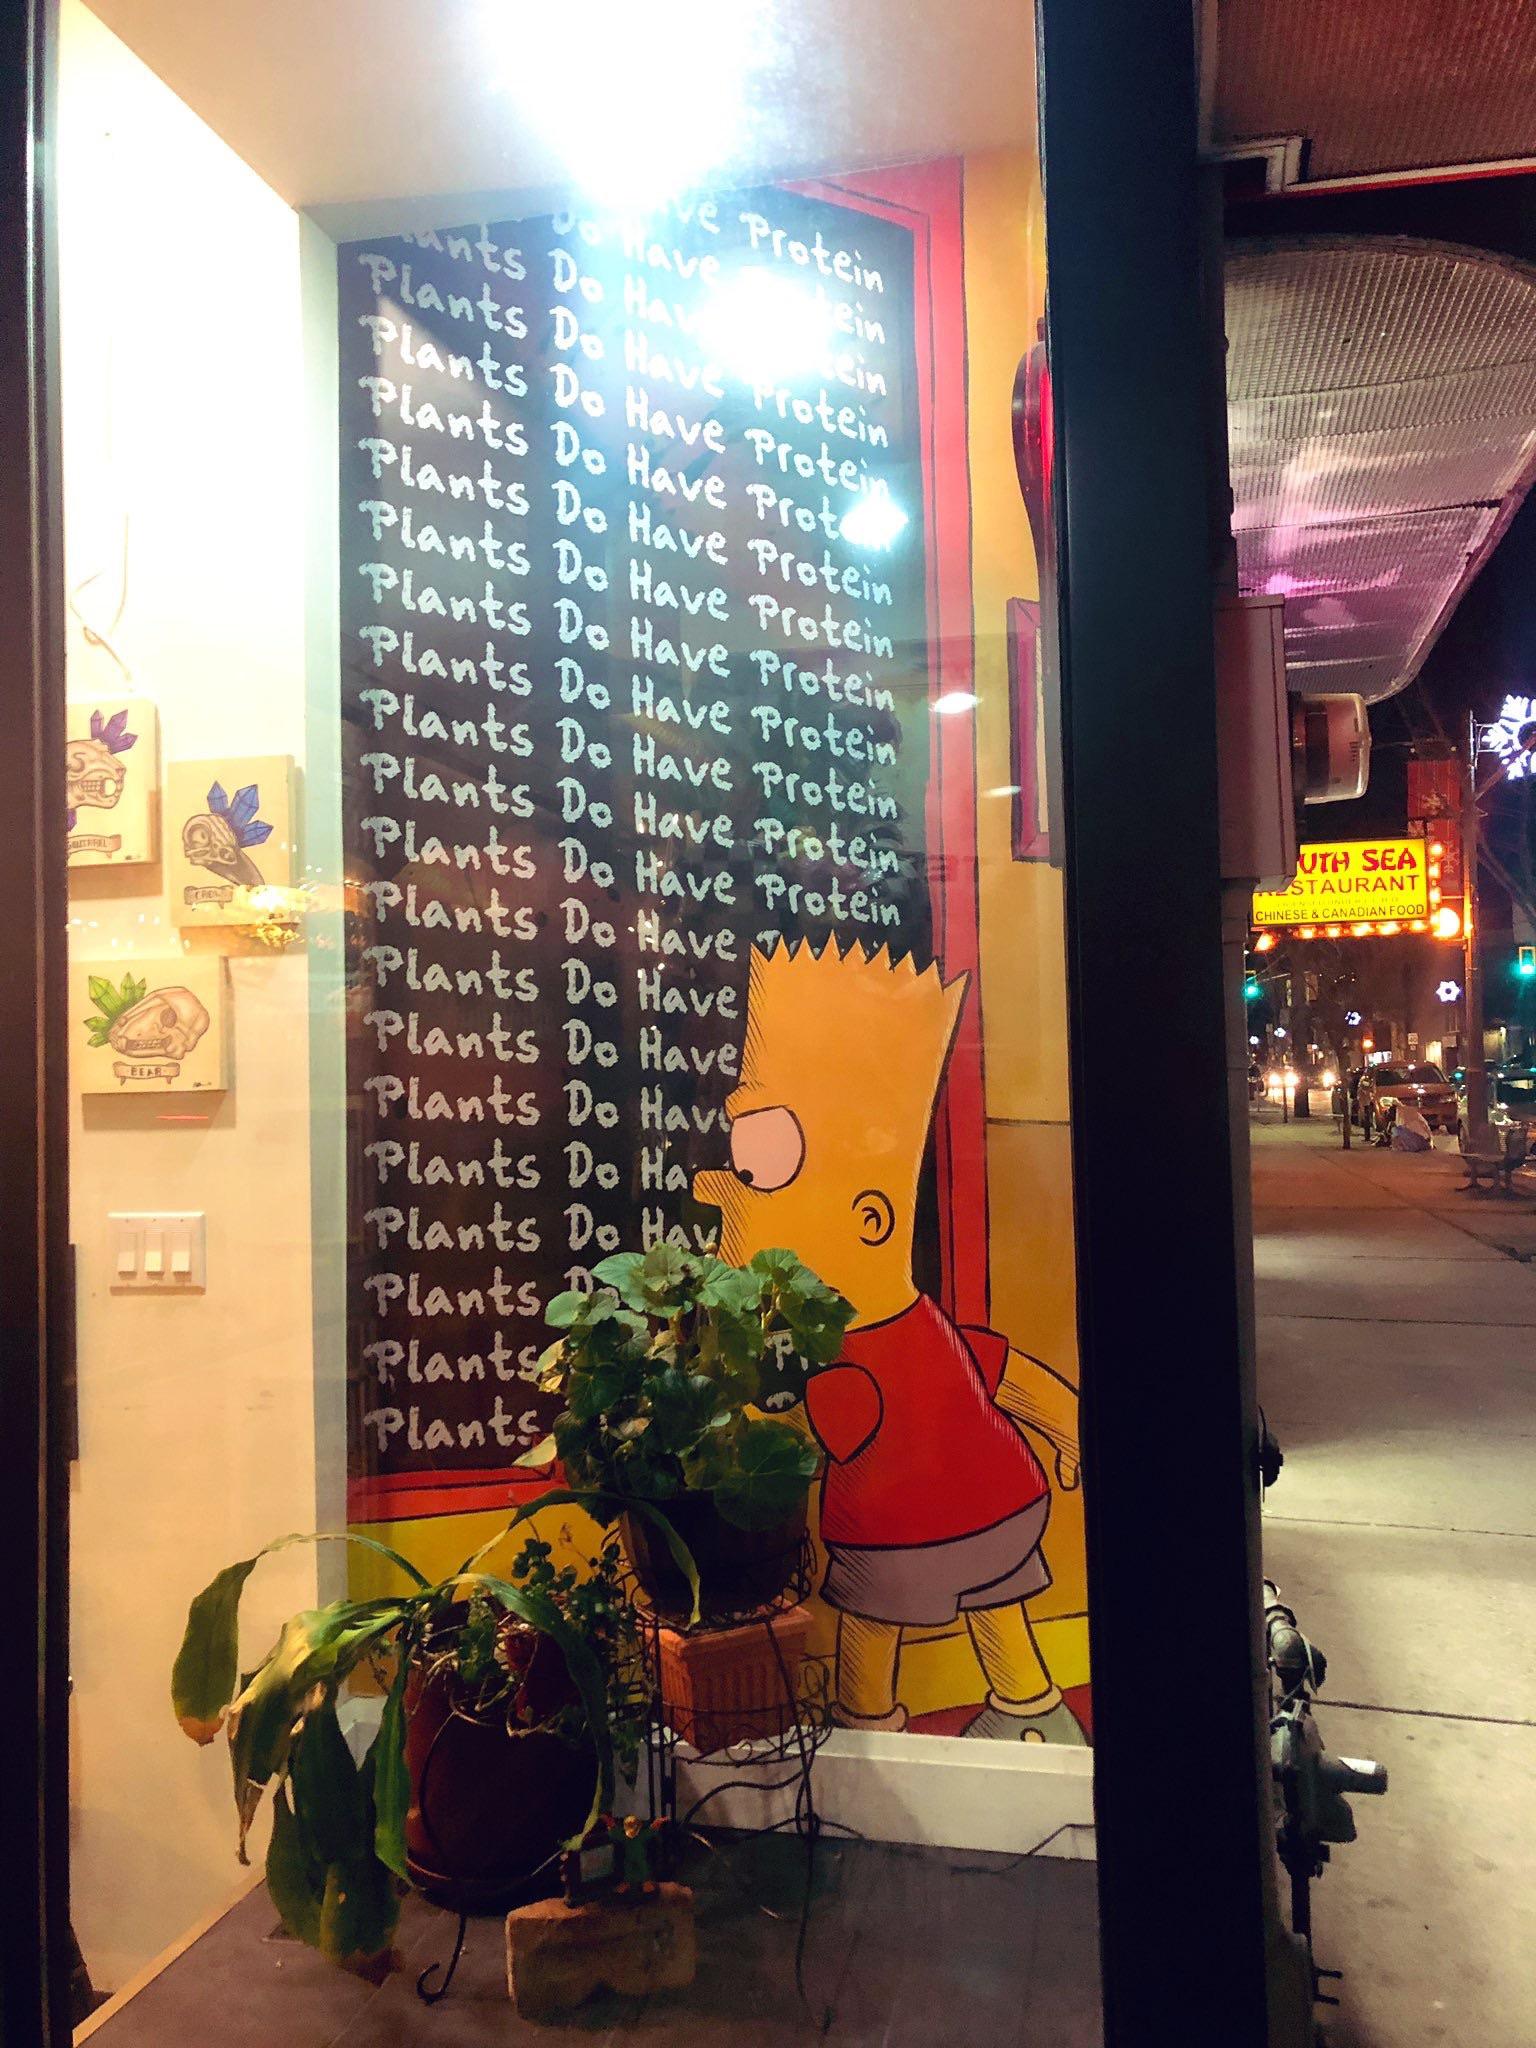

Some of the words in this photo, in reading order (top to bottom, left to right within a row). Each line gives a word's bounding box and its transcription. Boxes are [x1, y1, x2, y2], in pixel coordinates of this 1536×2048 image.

[401, 223, 527, 281] ants
[548, 248, 604, 304] Do
[624, 273, 702, 336] Hav
[738, 211, 884, 293] Protein
[360, 254, 528, 339] Plants
[549, 306, 604, 361] Do
[359, 315, 528, 397] Plants
[549, 363, 604, 416] Do
[626, 385, 726, 454] Have
[358, 376, 529, 456] Plants
[550, 421, 606, 475] Do
[627, 443, 727, 509] Have
[746, 484, 870, 548] Prot
[358, 438, 530, 516] Plants
[551, 480, 608, 533] Do
[629, 501, 728, 565] Have
[747, 539, 892, 606] Protein
[359, 500, 531, 576] Plants
[552, 539, 609, 591] Do
[630, 559, 729, 621] Have
[748, 594, 894, 660] Protein
[359, 563, 532, 636] Plants
[553, 598, 610, 651] Do
[631, 616, 730, 678] Have
[750, 650, 895, 713] Protein
[359, 625, 533, 696] Plants
[554, 657, 611, 709] Do
[632, 674, 732, 735] Have
[751, 705, 896, 767] Protein
[359, 689, 534, 757] Plants
[555, 717, 612, 769] Do
[633, 733, 733, 791] Have
[752, 761, 898, 822] Protein
[360, 752, 535, 818] Plants
[556, 777, 613, 828] Do
[634, 791, 734, 848] Have
[753, 818, 899, 874] Protein
[360, 816, 536, 879] Plants
[558, 837, 615, 888] Do
[636, 850, 736, 905] Have
[755, 873, 901, 927] Protein
[1258, 875, 1420, 896] STAURANT
[1299, 851, 1350, 874] UTH
[1362, 848, 1417, 872] SEA
[362, 881, 538, 940] Plants
[559, 898, 616, 948] Do
[637, 909, 737, 962] Have
[1255, 909, 1308, 922] CHINESE
[1311, 909, 1319, 919] &
[1322, 906, 1386, 919] CANADIAN
[1389, 904, 1425, 916] FOOD
[363, 944, 539, 1002] Plants
[561, 958, 618, 1008] Do
[638, 966, 738, 1019] Have
[363, 1010, 540, 1063] Plants
[562, 1018, 619, 1068] Do
[640, 1025, 738, 1076] Have
[363, 1075, 541, 1126] Plants
[562, 1079, 619, 1128] Do
[363, 1138, 541, 1189] Plants
[563, 1141, 620, 1190] Do
[640, 1146, 712, 1192] Ha
[363, 1201, 541, 1253] Plants
[563, 1203, 621, 1252] Do
[641, 1206, 720, 1253] Hav
[363, 1266, 541, 1317] Plants
[363, 1331, 539, 1384] Plants
[363, 1396, 540, 1452] Plants
